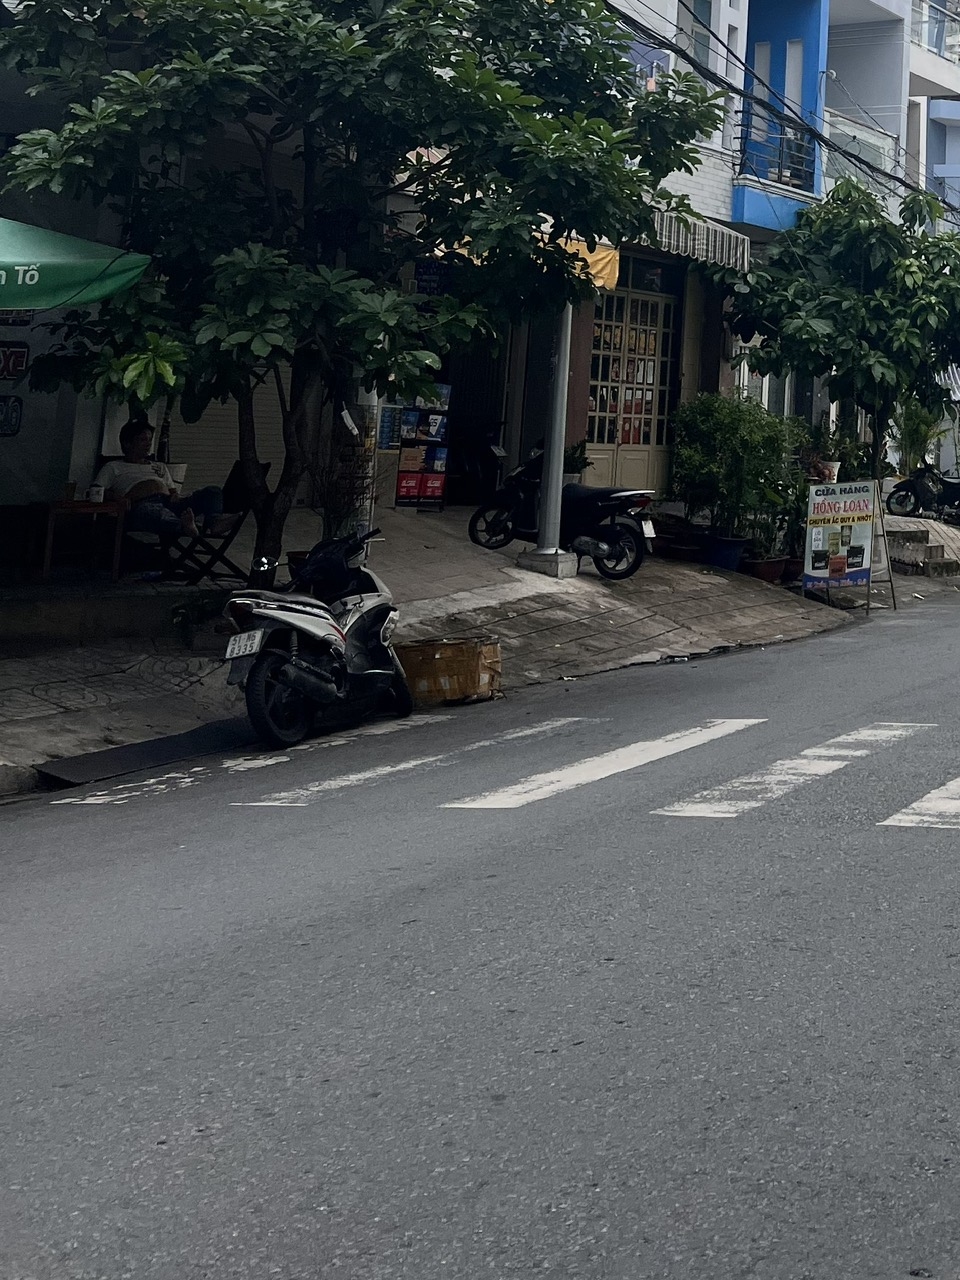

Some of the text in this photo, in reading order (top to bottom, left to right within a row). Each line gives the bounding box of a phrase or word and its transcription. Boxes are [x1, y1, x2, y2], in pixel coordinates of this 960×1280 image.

[14, 263, 41, 285] Tố
[815, 485, 869, 497] CỬA HÀNG
[812, 498, 870, 515] HỒNG LOAN
